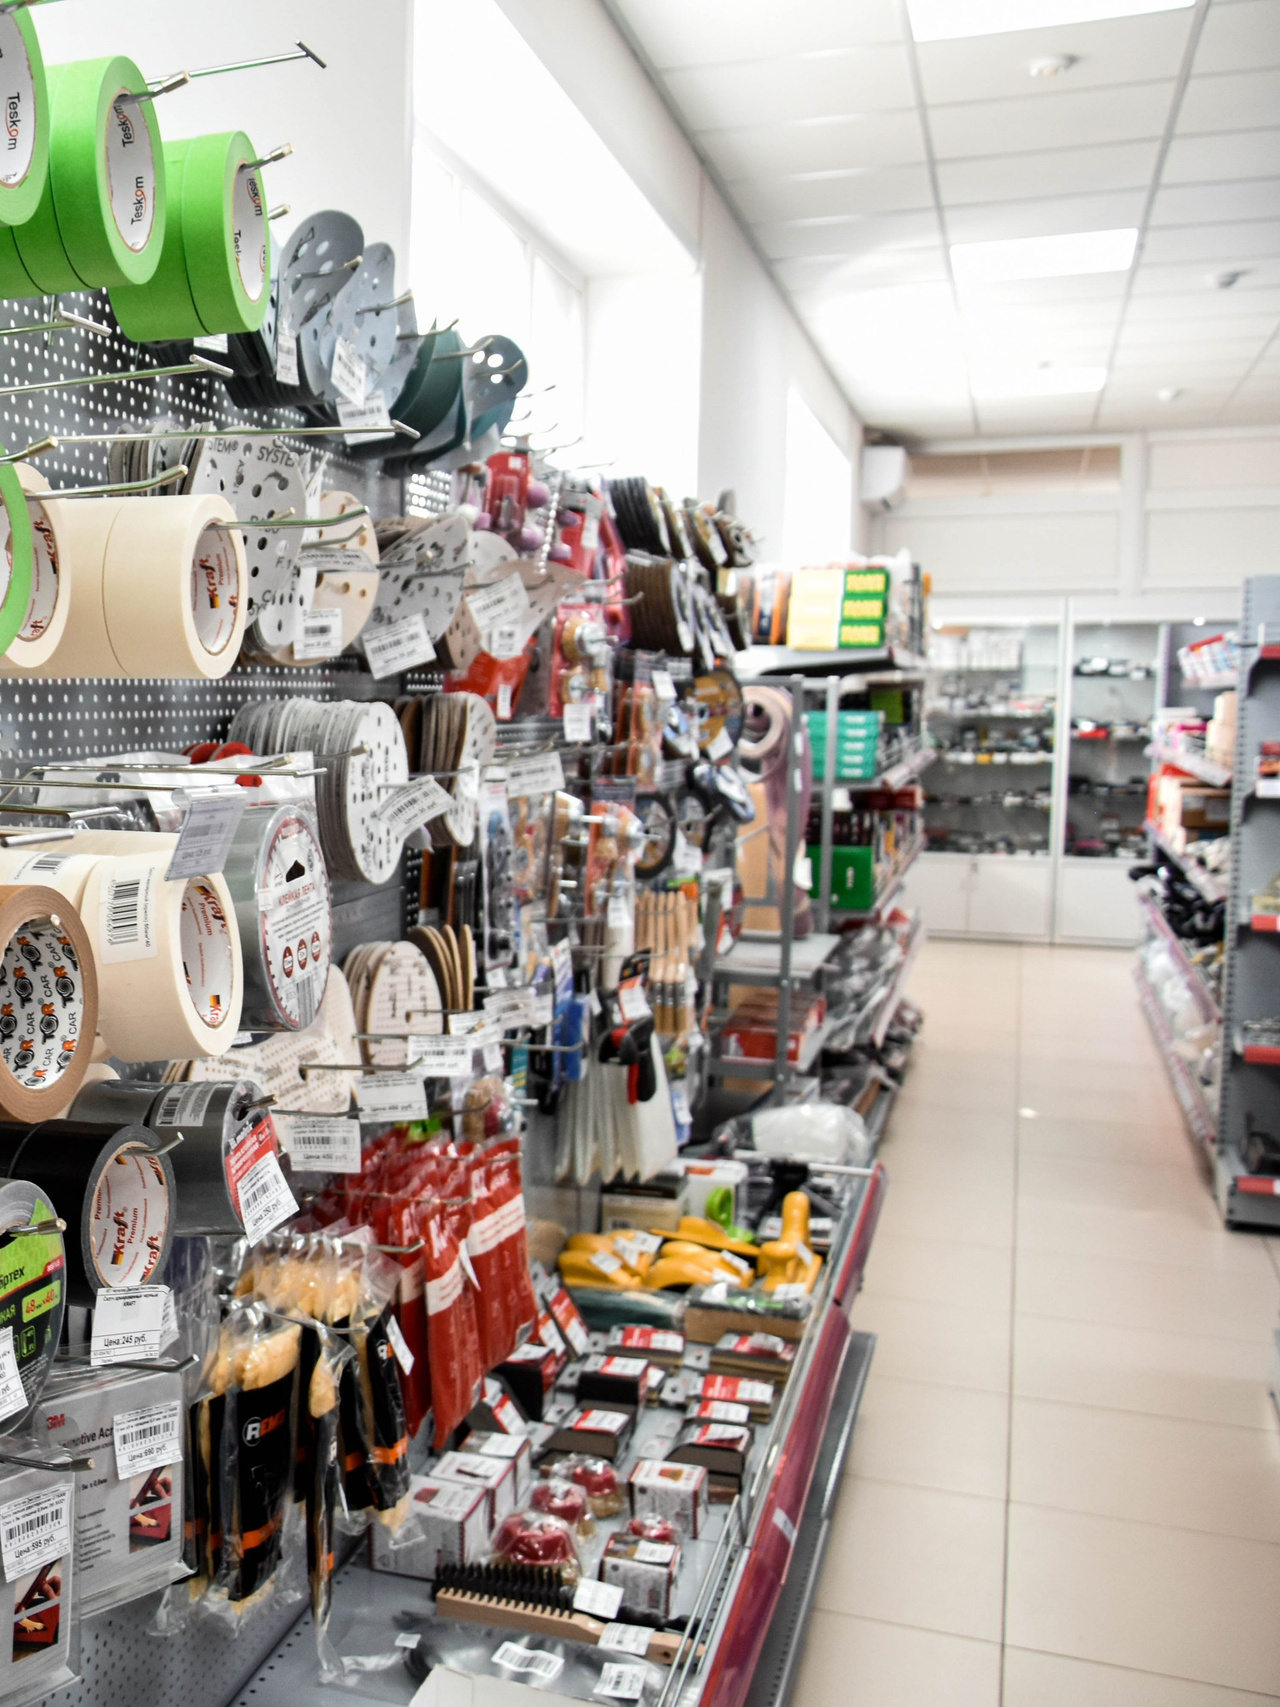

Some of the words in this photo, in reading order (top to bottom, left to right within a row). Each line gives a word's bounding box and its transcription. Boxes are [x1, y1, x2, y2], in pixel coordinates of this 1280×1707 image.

[7, 92, 20, 150] Teskom
[131, 176, 145, 225] Teskom
[199, 558, 218, 597] Kraft
[199, 902, 213, 936] Premium
[113, 1211, 128, 1253] Kraft
[127, 1208, 138, 1244] Premium
[144, 1236, 160, 1276] Kraft
[134, 1334, 146, 1345] руб.
[46, 1413, 66, 1431] 3M
[156, 1445, 168, 1454] руб.
[43, 1534, 55, 1547] руб.
